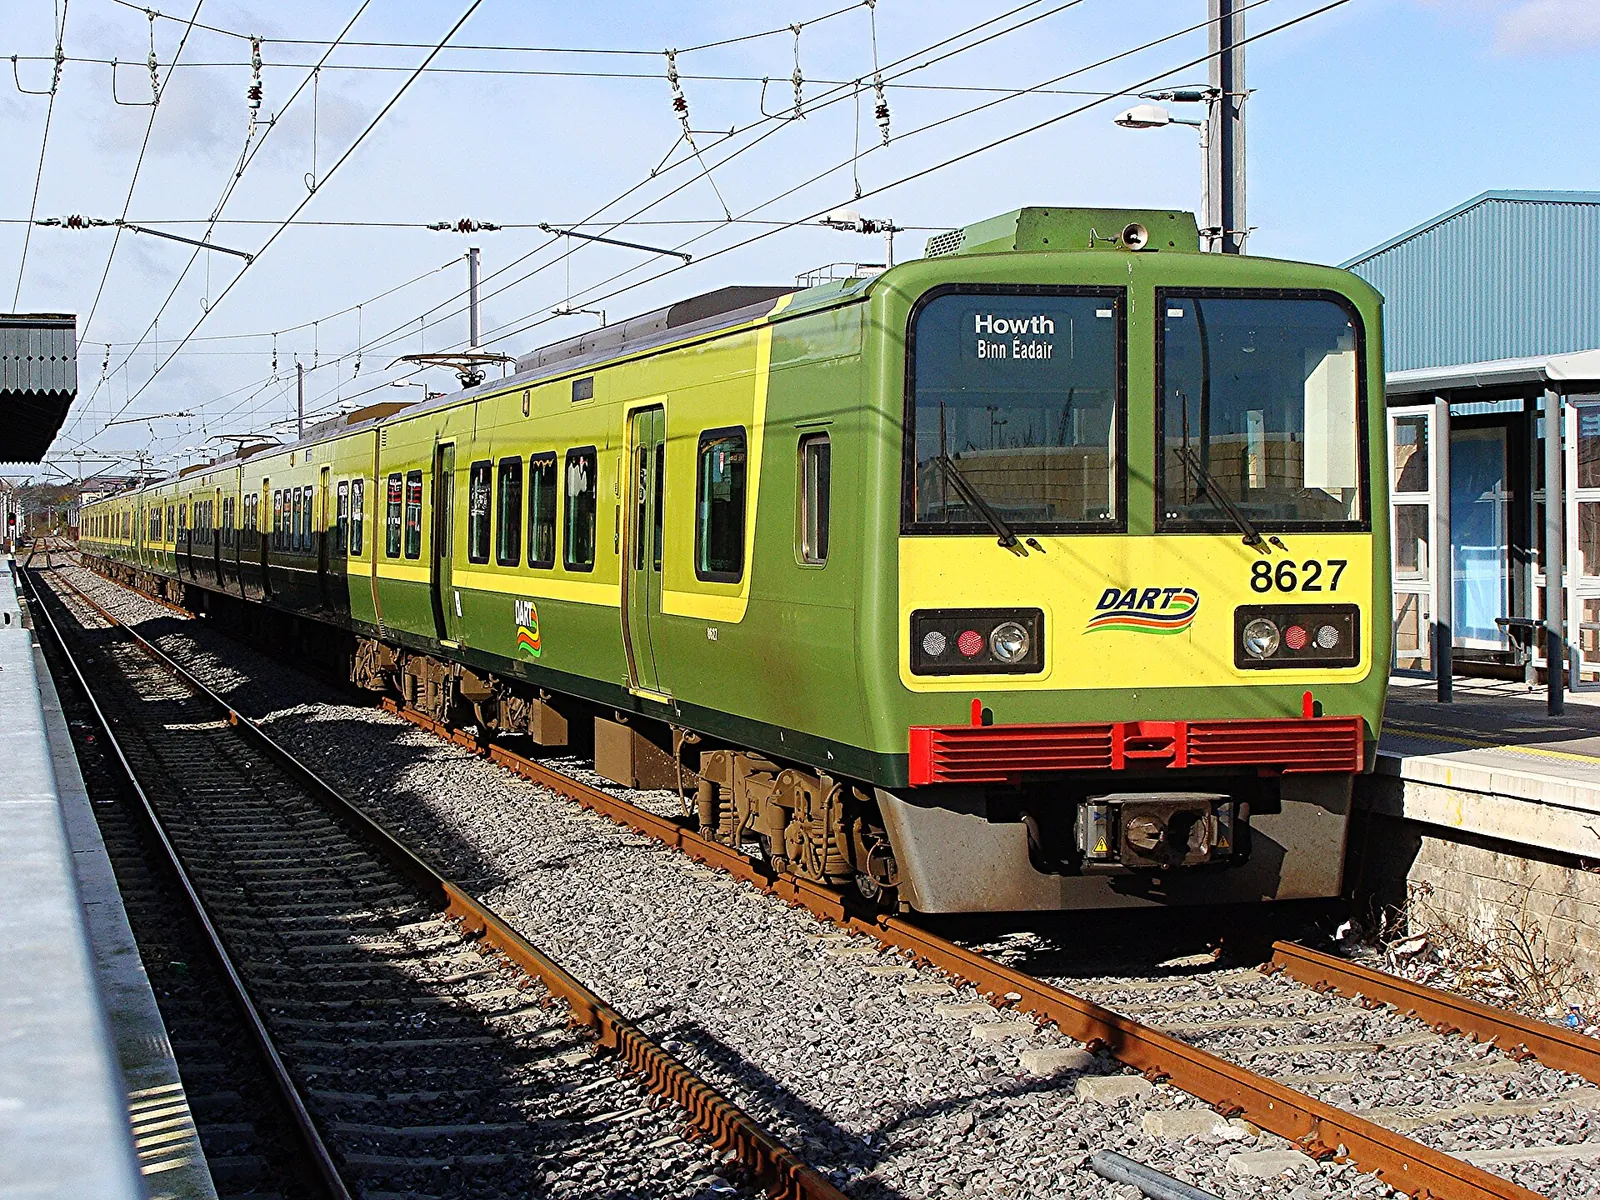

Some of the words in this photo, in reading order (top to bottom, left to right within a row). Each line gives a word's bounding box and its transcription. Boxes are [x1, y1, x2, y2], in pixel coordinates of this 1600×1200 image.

[975, 314, 1055, 334] Howth
[977, 339, 1006, 359] Binn
[1012, 335, 1053, 359] Éadair
[1250, 560, 1348, 592] 8627
[1095, 588, 1184, 610] DART
[515, 600, 535, 627] DART
